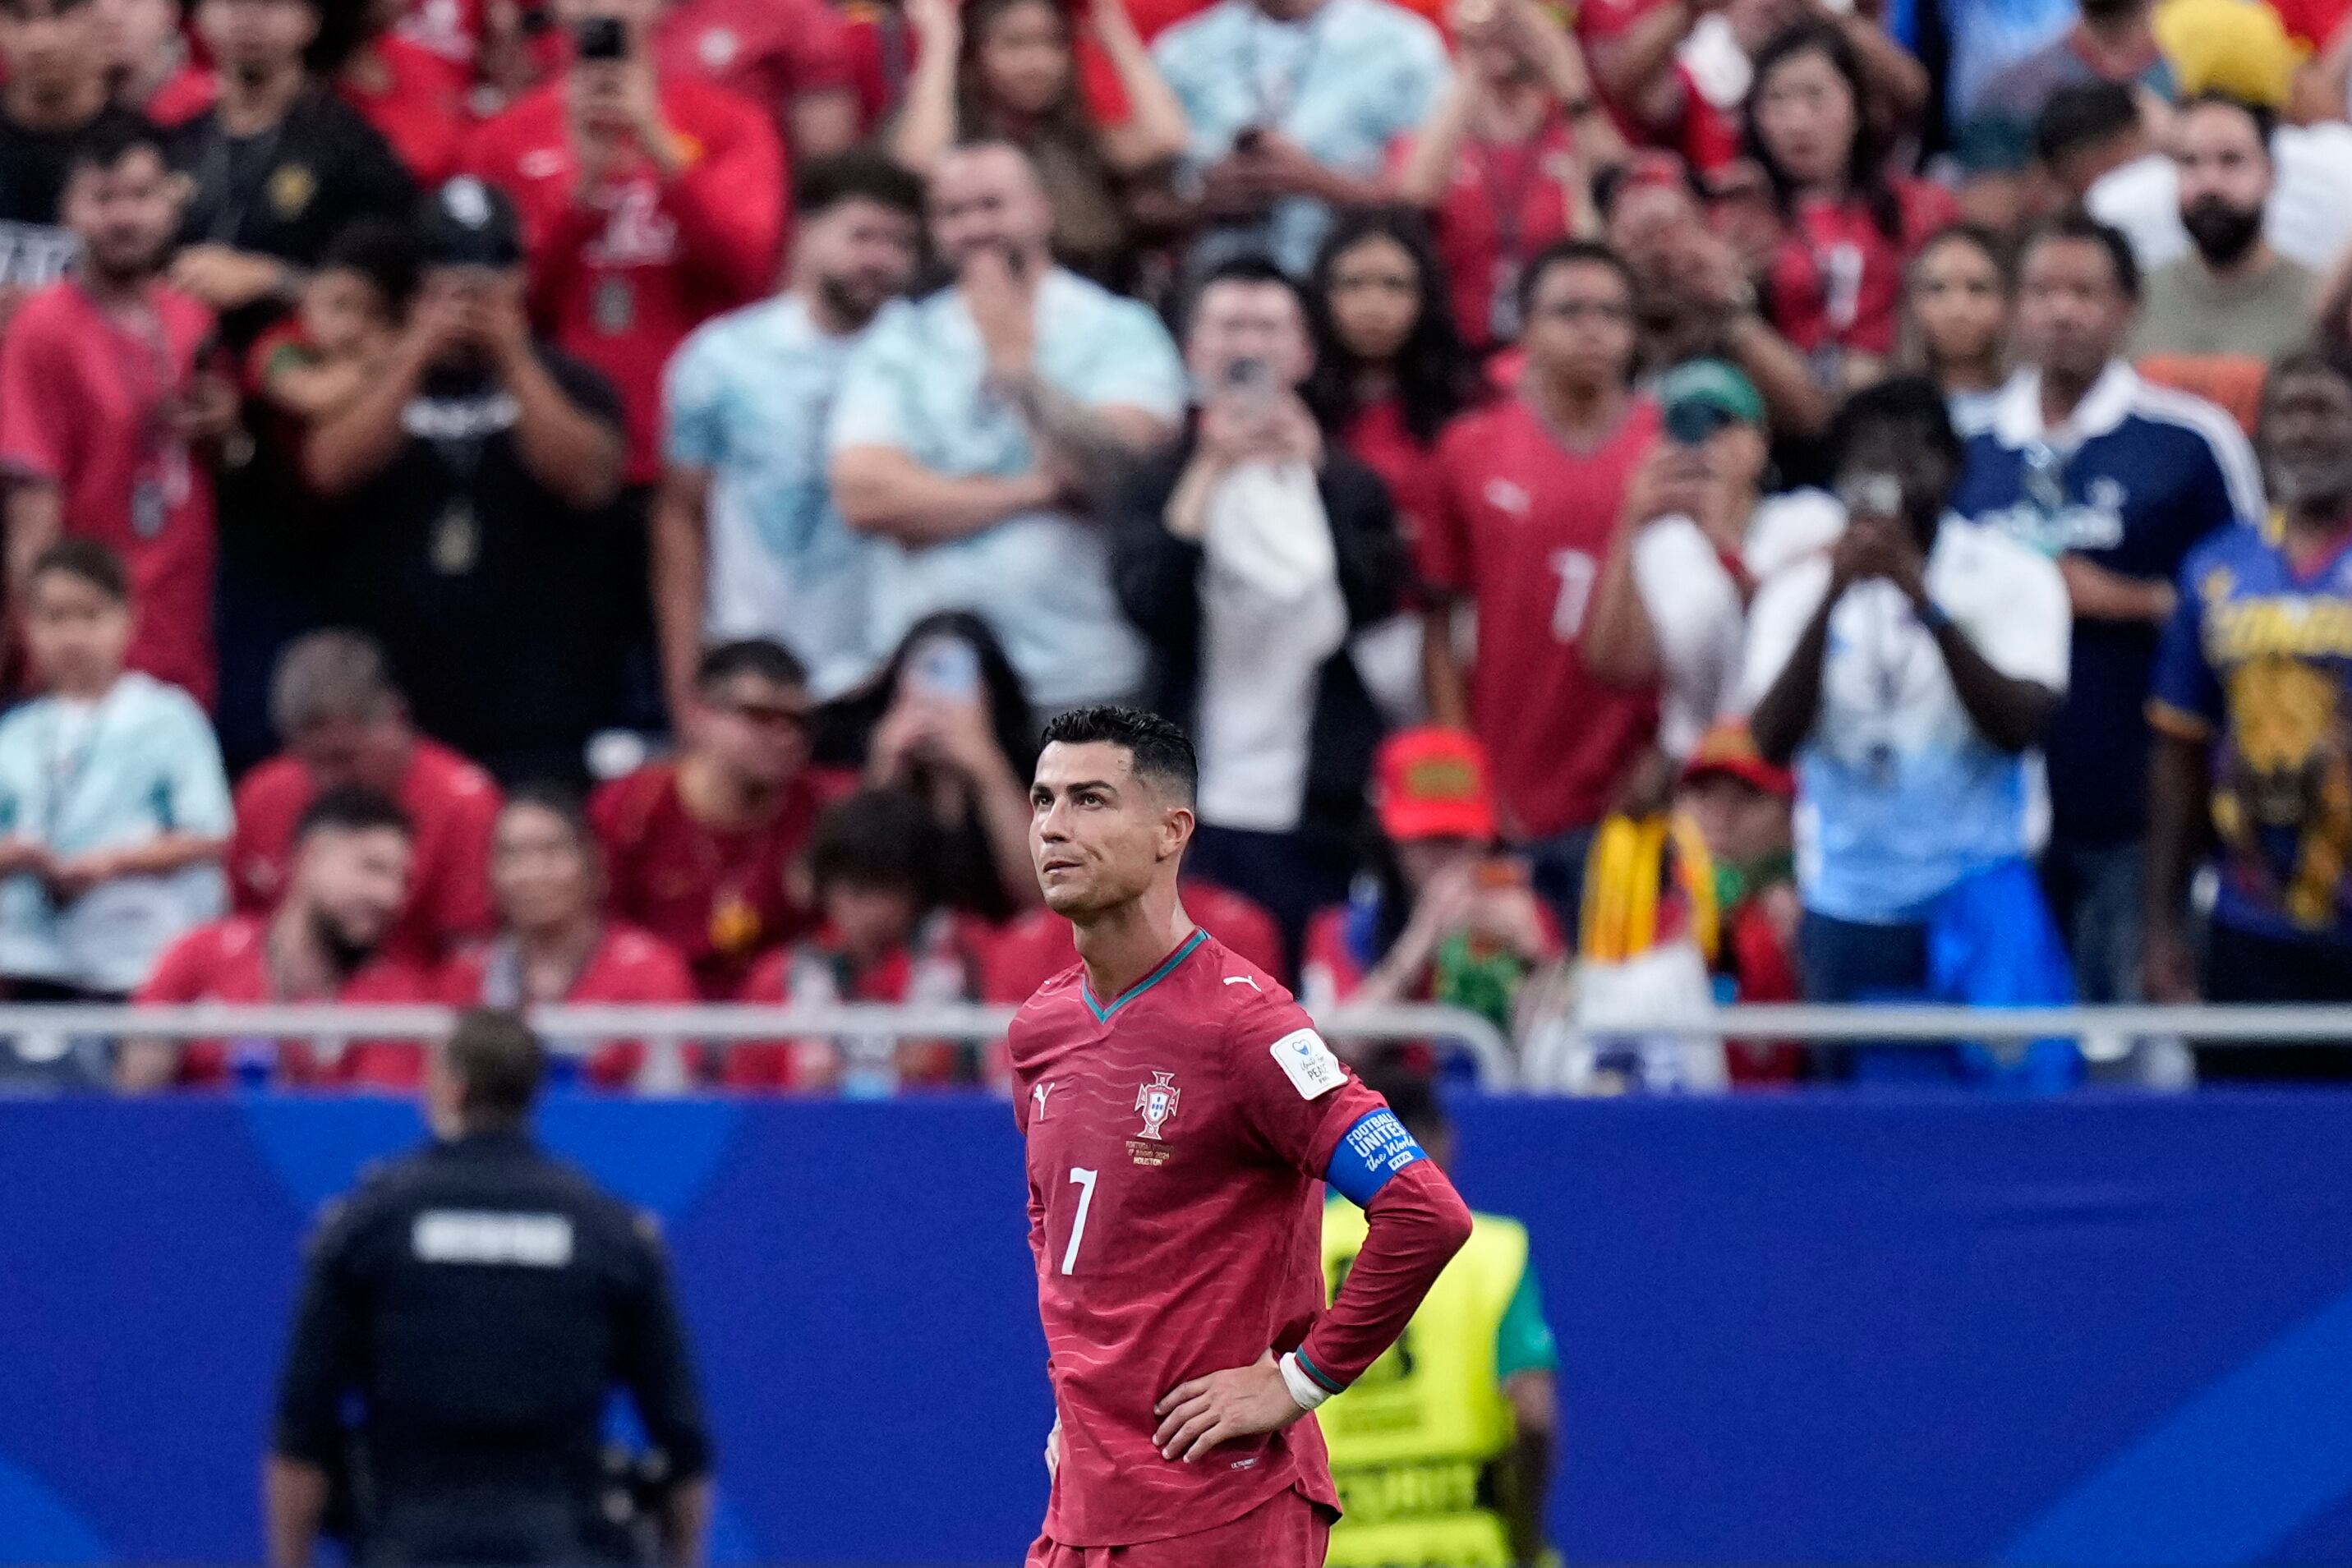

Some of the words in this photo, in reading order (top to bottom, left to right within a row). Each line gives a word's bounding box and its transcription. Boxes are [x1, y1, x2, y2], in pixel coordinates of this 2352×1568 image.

[1346, 1113, 1397, 1146] FOOTBALL
[1354, 1121, 1406, 1157] UNITES
[1134, 1156, 1163, 1166] HOUSTON
[1365, 1153, 1387, 1172] the
[1390, 1153, 1411, 1167] FIFA
[1061, 1167, 1098, 1275] 7
